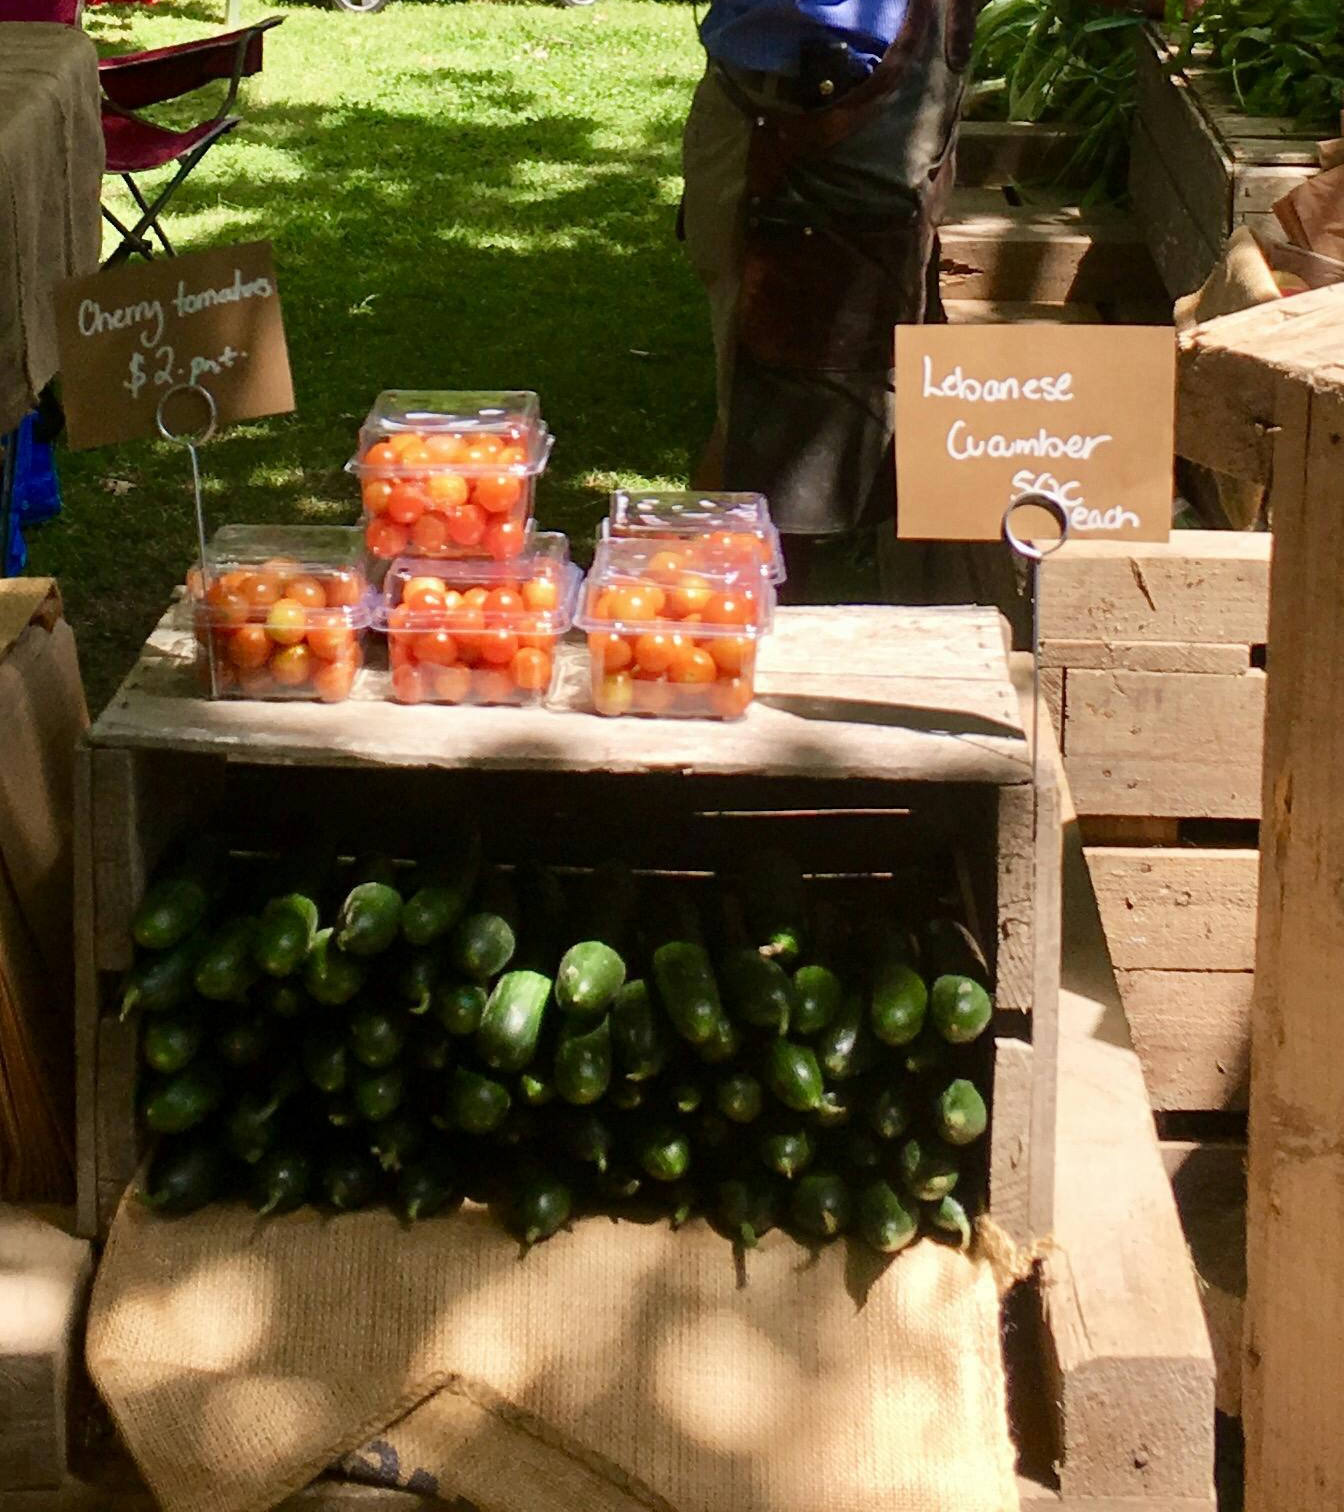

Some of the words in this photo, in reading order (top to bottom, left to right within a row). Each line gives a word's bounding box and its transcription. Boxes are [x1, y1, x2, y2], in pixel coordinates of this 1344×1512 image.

[79, 299, 164, 348] Cherry
[923, 354, 1074, 402] Lebanese
[1070, 504, 1140, 530] each
